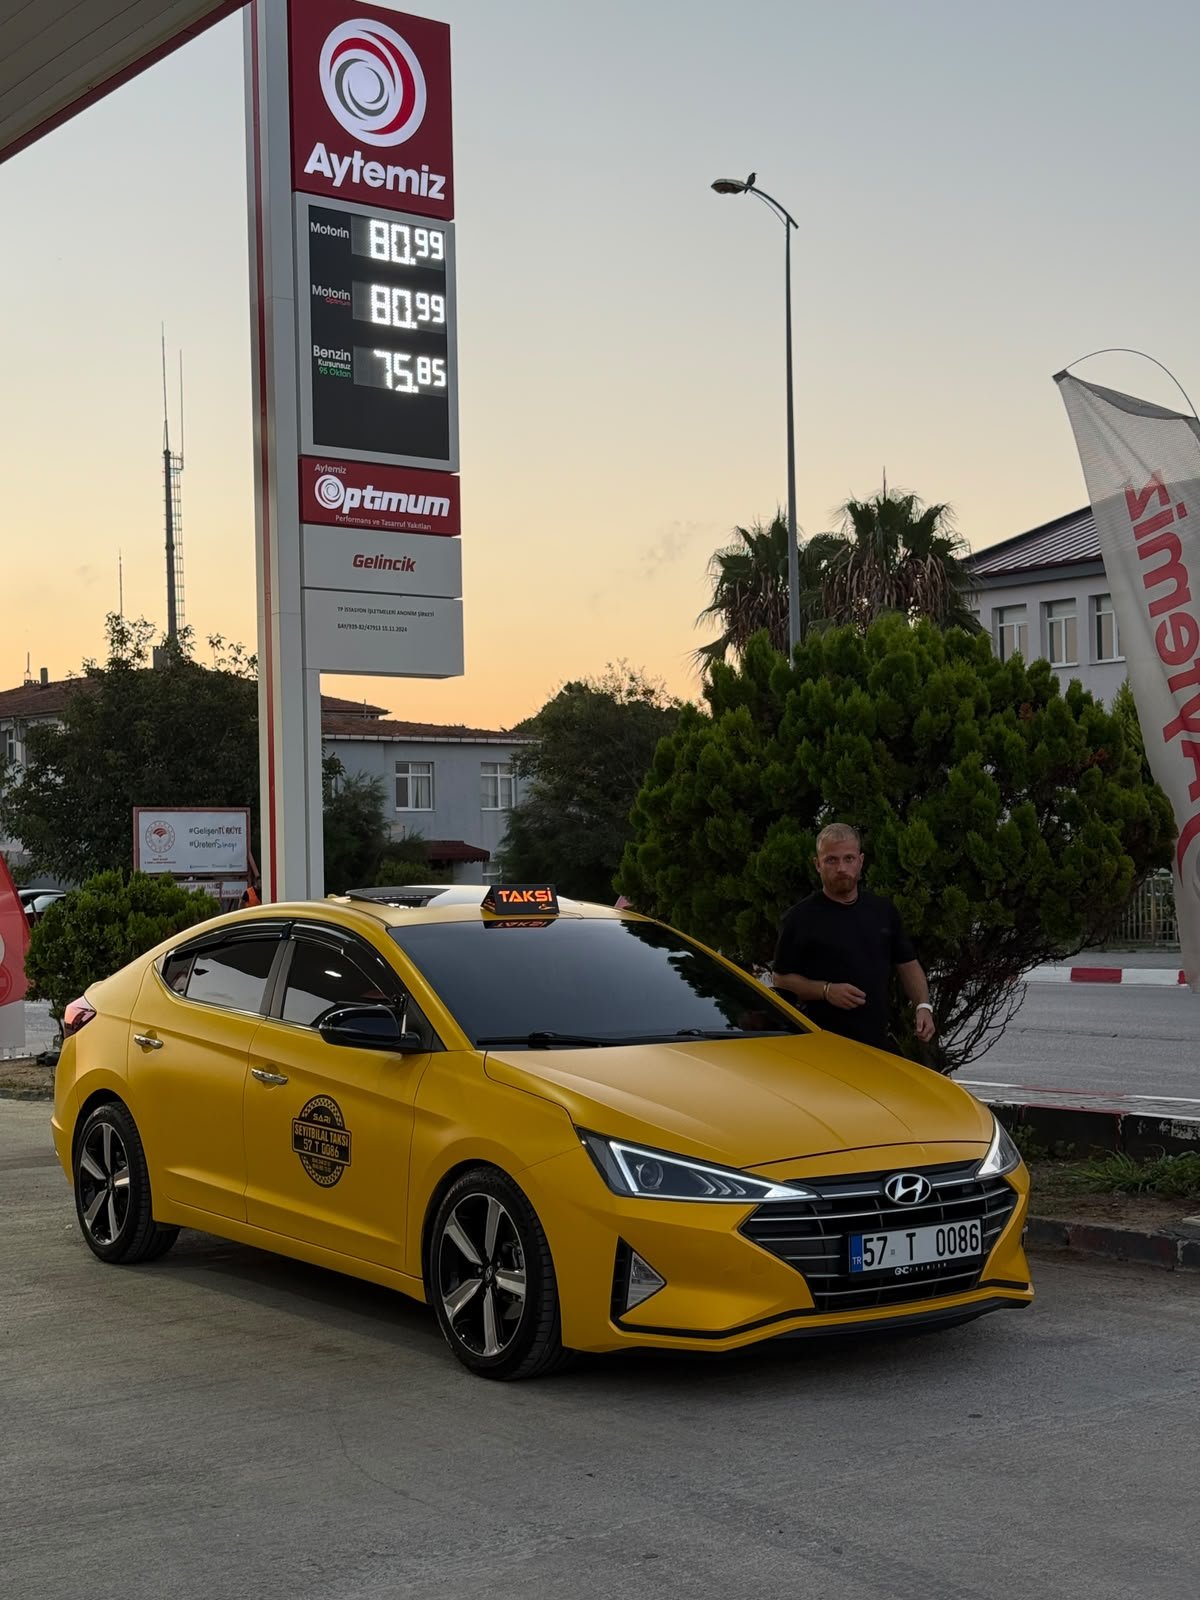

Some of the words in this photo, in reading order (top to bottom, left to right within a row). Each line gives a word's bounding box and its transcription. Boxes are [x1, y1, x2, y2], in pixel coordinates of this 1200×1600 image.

[304, 142, 446, 200] Aytemiz
[310, 221, 350, 239] Motorin
[369, 219, 444, 265] 80.99
[312, 284, 351, 301] Motorin
[370, 283, 445, 329] 80.99
[313, 345, 351, 362] Benzin
[318, 358, 351, 370] Kurşunsuz
[319, 366, 328, 375] 95
[330, 368, 351, 378] Oktan
[373, 349, 447, 393] 75.85
[314, 463, 346, 474] Aytemiz
[314, 474, 450, 517] Optimum
[335, 514, 371, 525] Performans
[381, 519, 406, 528] Tasarruf
[406, 521, 432, 530] Yakıtları
[352, 554, 416, 572] Gelincik
[498, 887, 552, 903] TAKSİ
[313, 1113, 331, 1124] SARI
[303, 1138, 313, 1151] 57
[314, 1140, 320, 1153] T
[321, 1142, 339, 1158] 0086
[863, 1235, 888, 1267] 57
[906, 1232, 916, 1261] T
[936, 1223, 979, 1257] 0086
[852, 1256, 862, 1265] TR
